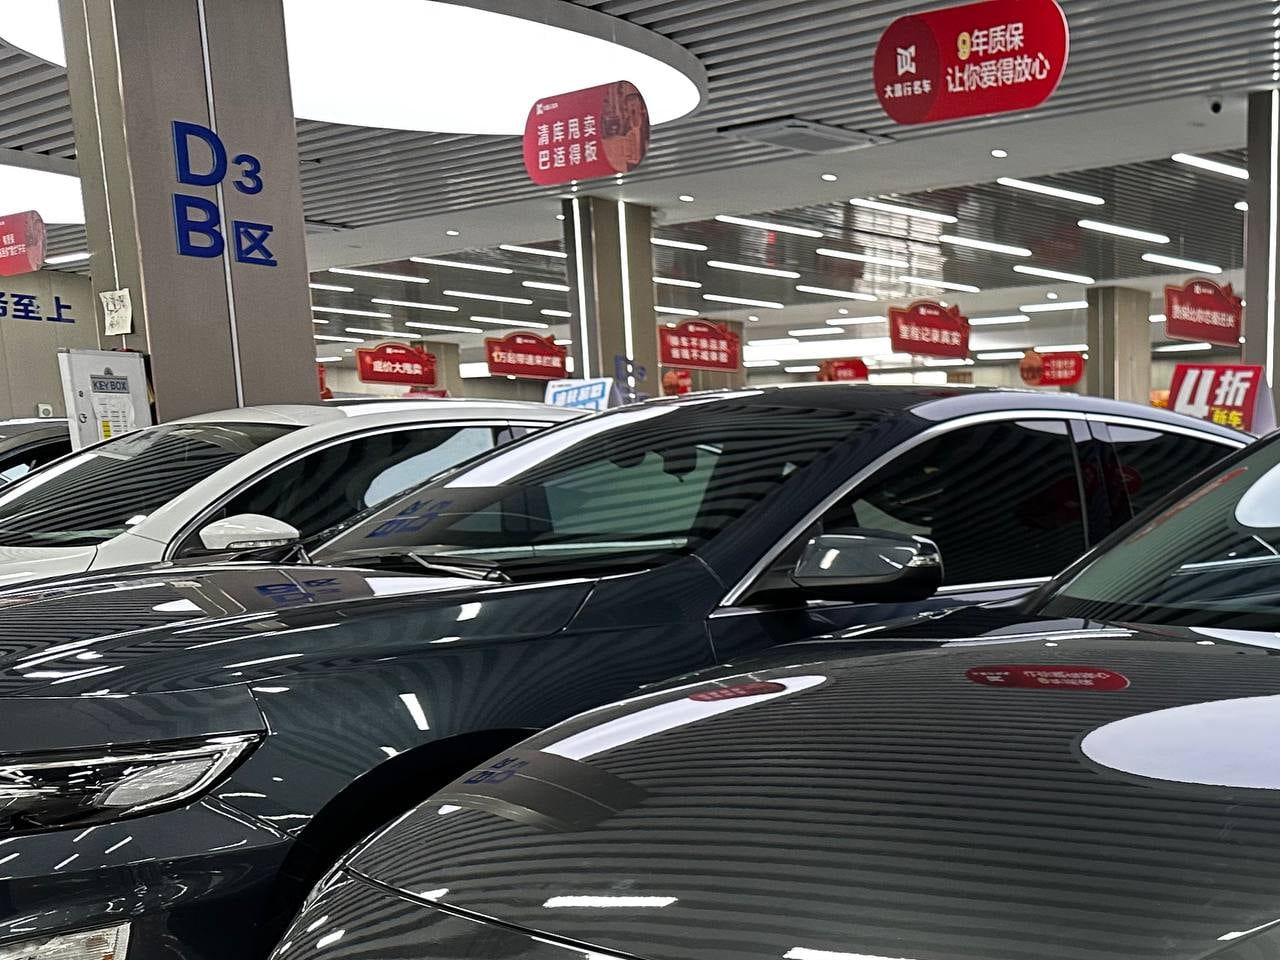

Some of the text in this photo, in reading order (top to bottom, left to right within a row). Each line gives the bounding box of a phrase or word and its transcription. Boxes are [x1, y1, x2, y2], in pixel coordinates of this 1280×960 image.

[957, 23, 1025, 60] 9年质保
[946, 52, 1051, 93] 让你爱得放心
[537, 114, 596, 146] 清库甩卖
[538, 141, 598, 170] 巴适得板
[93, 381, 127, 391] KEY BOX
